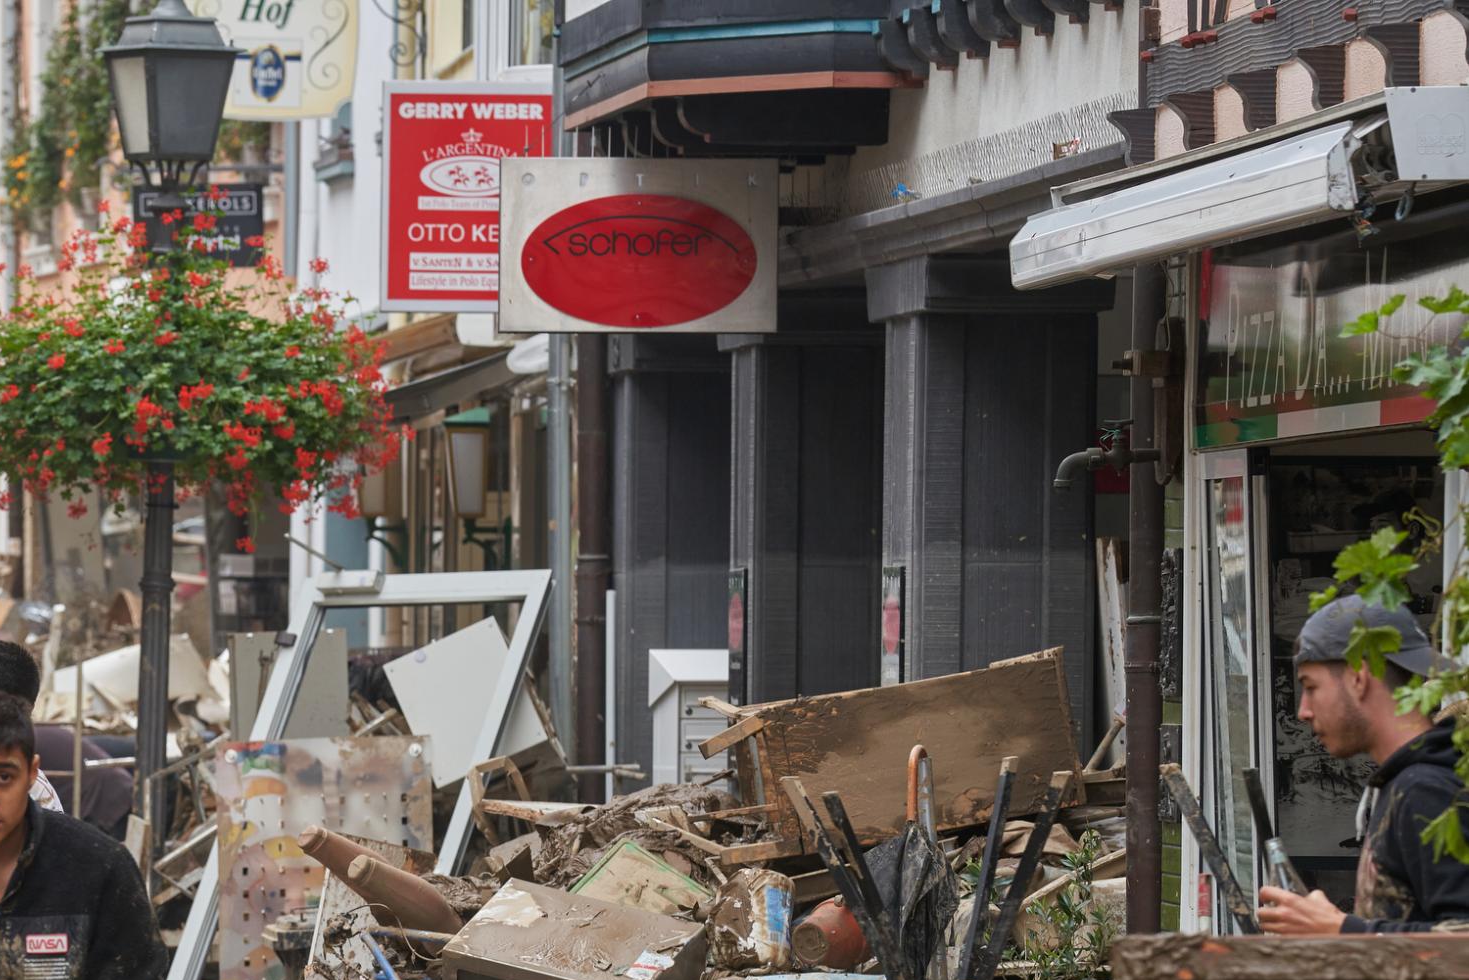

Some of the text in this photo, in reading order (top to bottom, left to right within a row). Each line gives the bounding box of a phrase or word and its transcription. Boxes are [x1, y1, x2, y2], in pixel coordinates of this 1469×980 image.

[239, 0, 294, 29] Hof
[398, 102, 544, 120] GERRY WEBER
[408, 223, 498, 242] OTTO KE
[412, 275, 446, 289] Lifestyle
[449, 276, 459, 286] in
[460, 275, 480, 287] Polo
[1225, 278, 1286, 411] PIZZA
[29, 938, 65, 951] NASA
